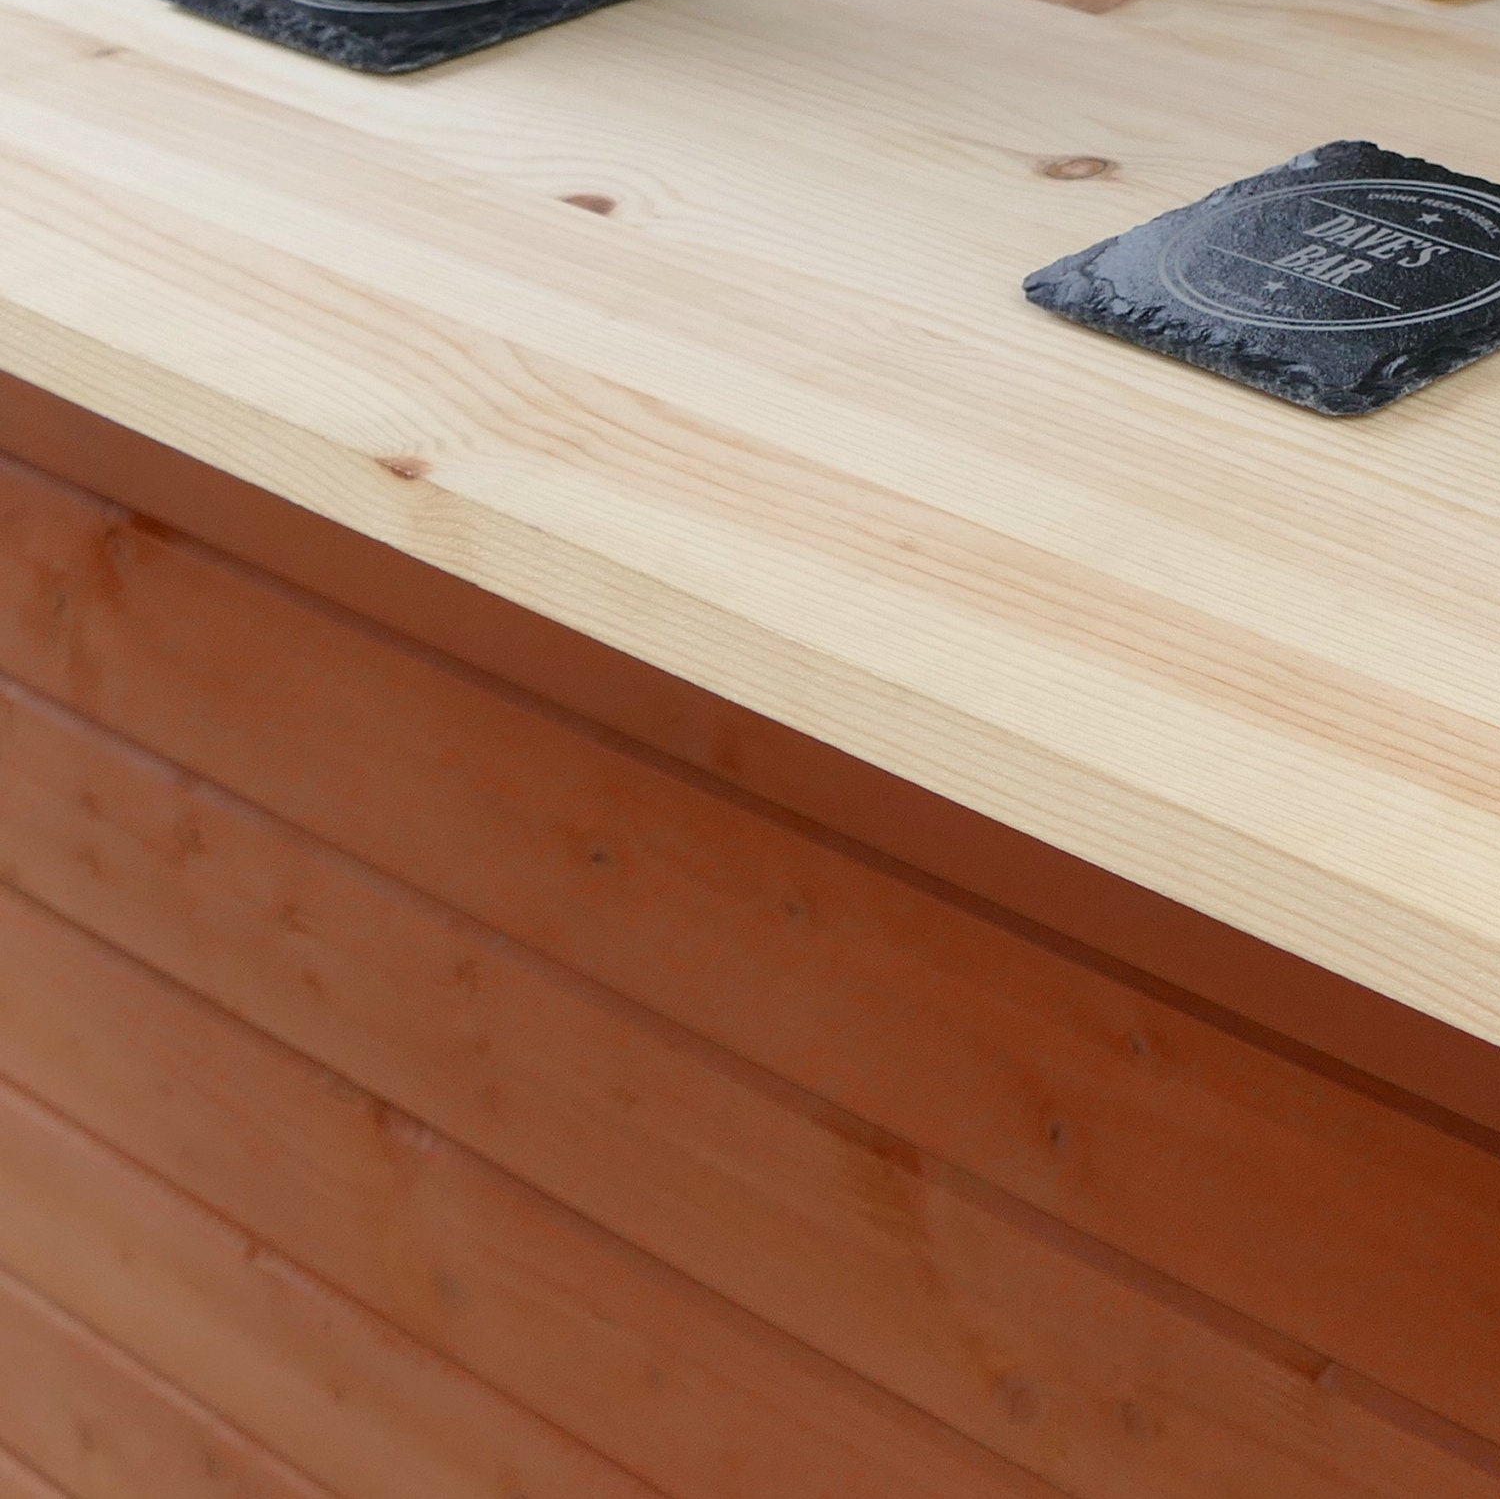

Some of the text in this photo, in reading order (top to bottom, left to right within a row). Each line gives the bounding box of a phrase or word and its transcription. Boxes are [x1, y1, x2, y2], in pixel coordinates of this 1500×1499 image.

[1367, 193, 1419, 203] DRINK
[1303, 213, 1450, 268] DAVE'S
[1273, 243, 1372, 285] BAR
